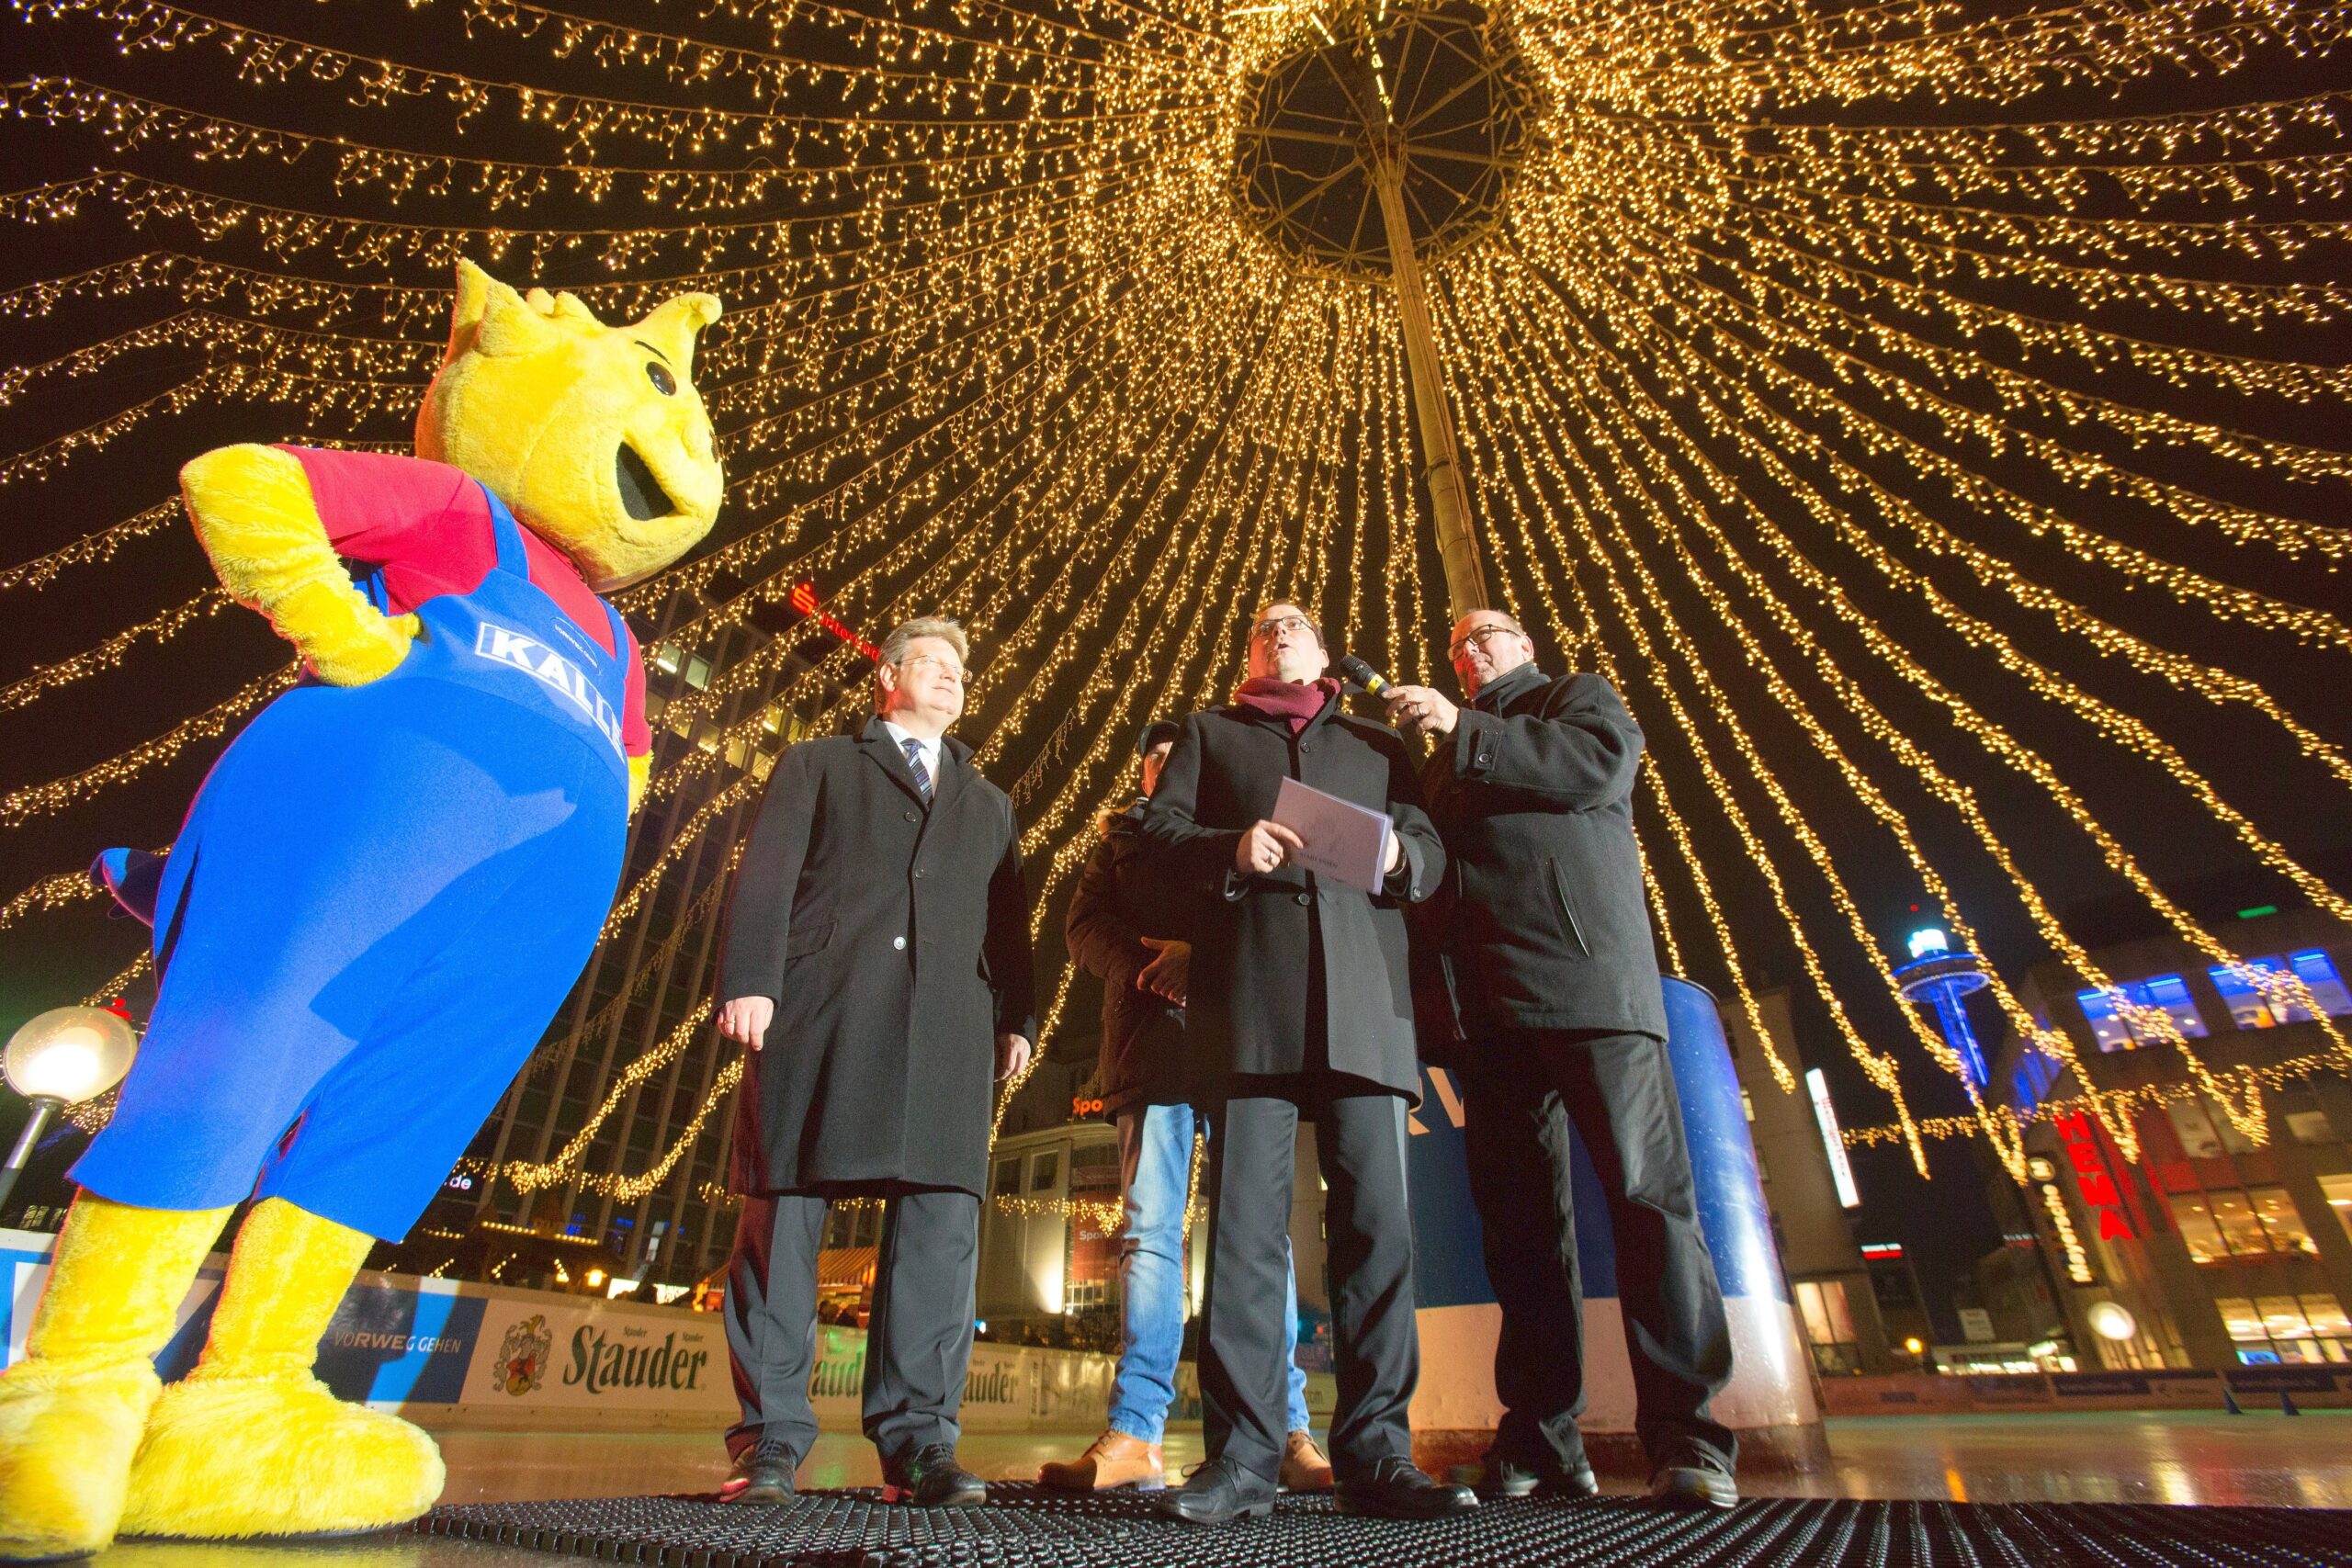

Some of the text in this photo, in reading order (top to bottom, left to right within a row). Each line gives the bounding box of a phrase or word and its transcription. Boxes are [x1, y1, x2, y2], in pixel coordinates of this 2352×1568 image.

[491, 629, 624, 759] KALLE
[2052, 1109, 2133, 1241] HEMA
[334, 1331, 462, 1353] VORWEG GEHEN
[562, 1325, 707, 1394] Stauder
